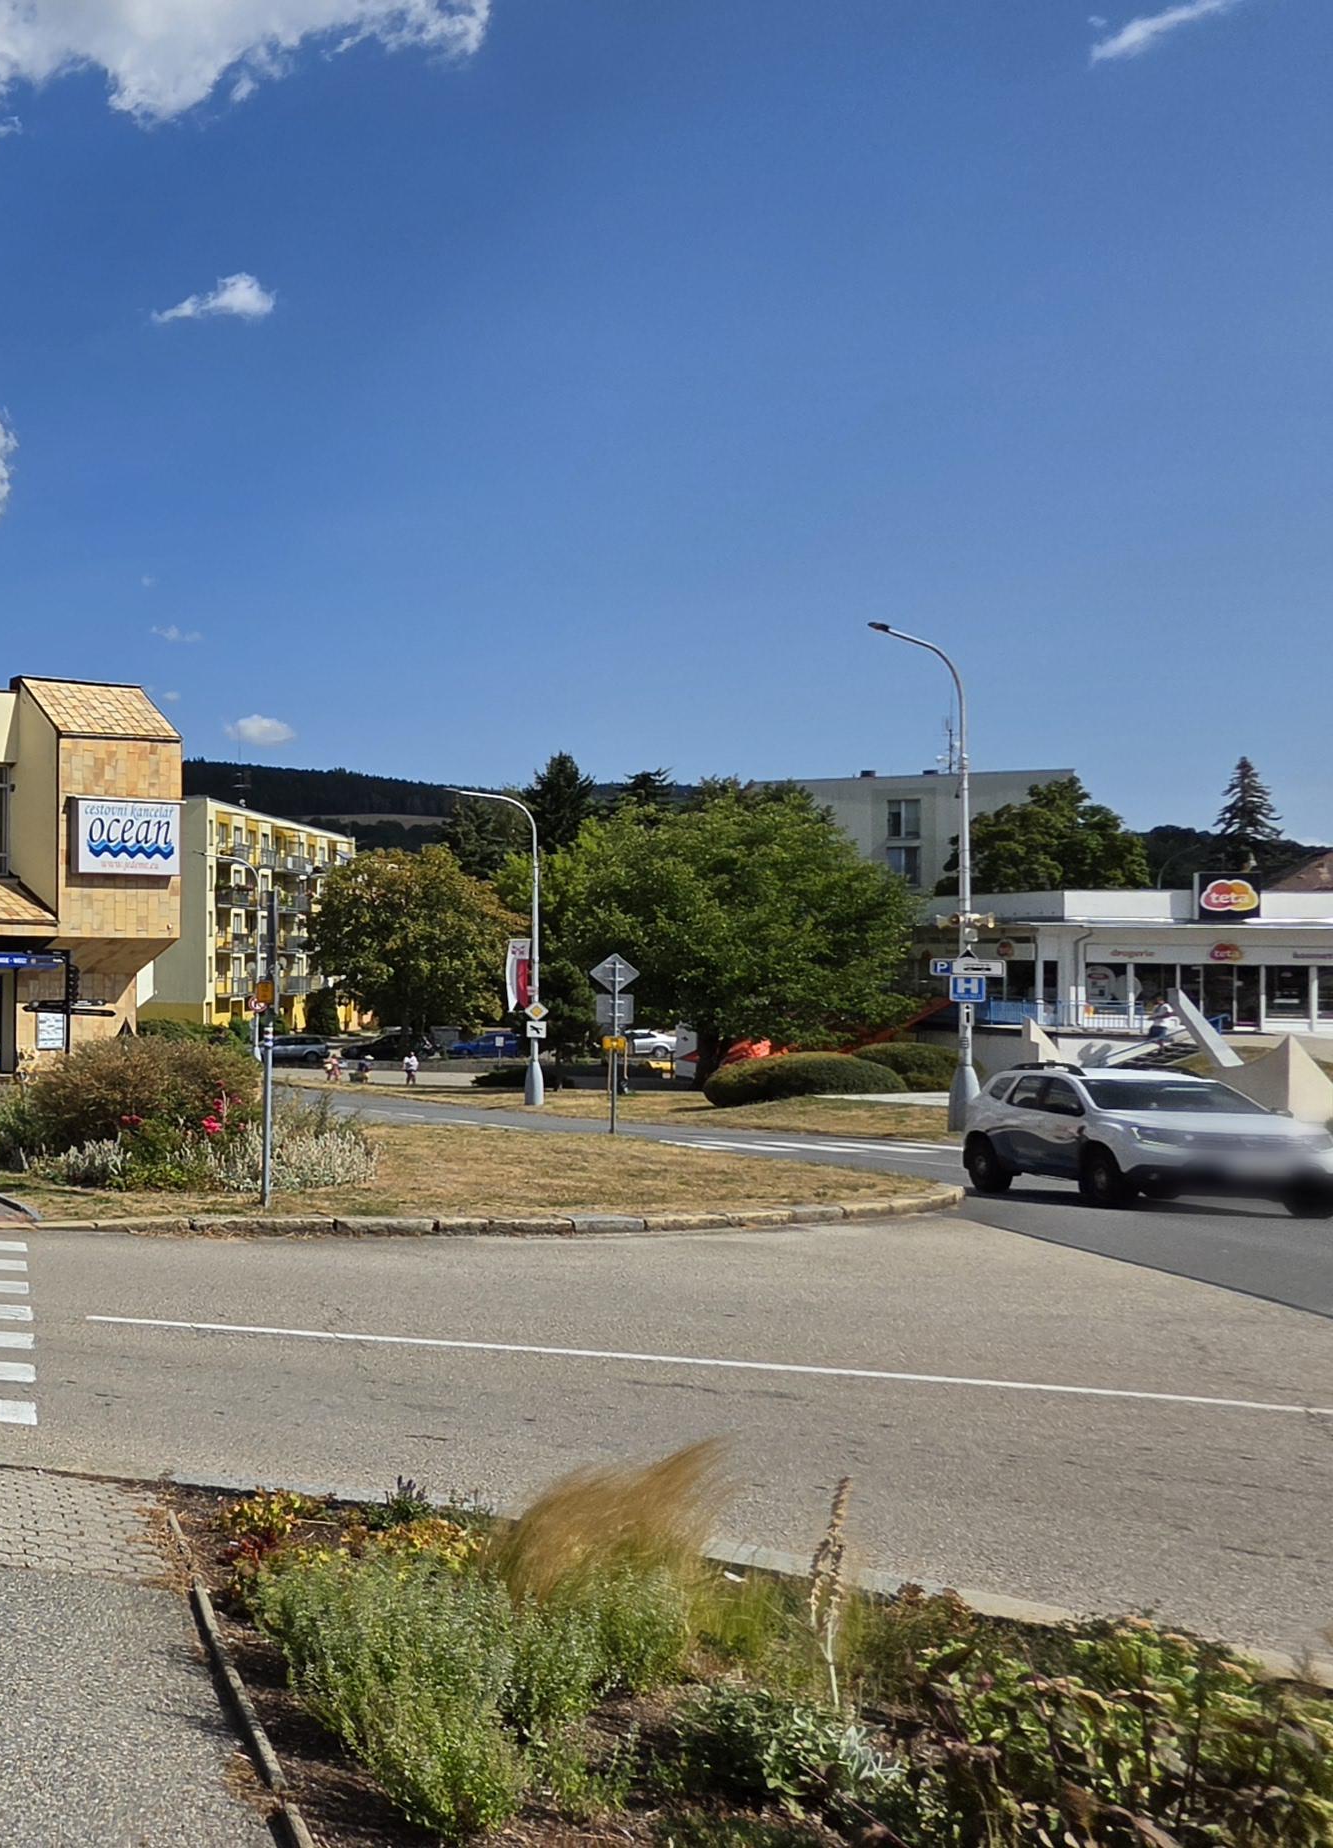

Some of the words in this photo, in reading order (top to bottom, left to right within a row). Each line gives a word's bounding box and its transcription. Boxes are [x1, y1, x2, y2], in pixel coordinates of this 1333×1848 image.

[84, 803, 128, 816] cestovní
[130, 804, 175, 820] kancelář
[88, 817, 172, 845] ocean
[1209, 892, 1250, 903] teta
[936, 961, 948, 973] P
[956, 978, 979, 993] H
